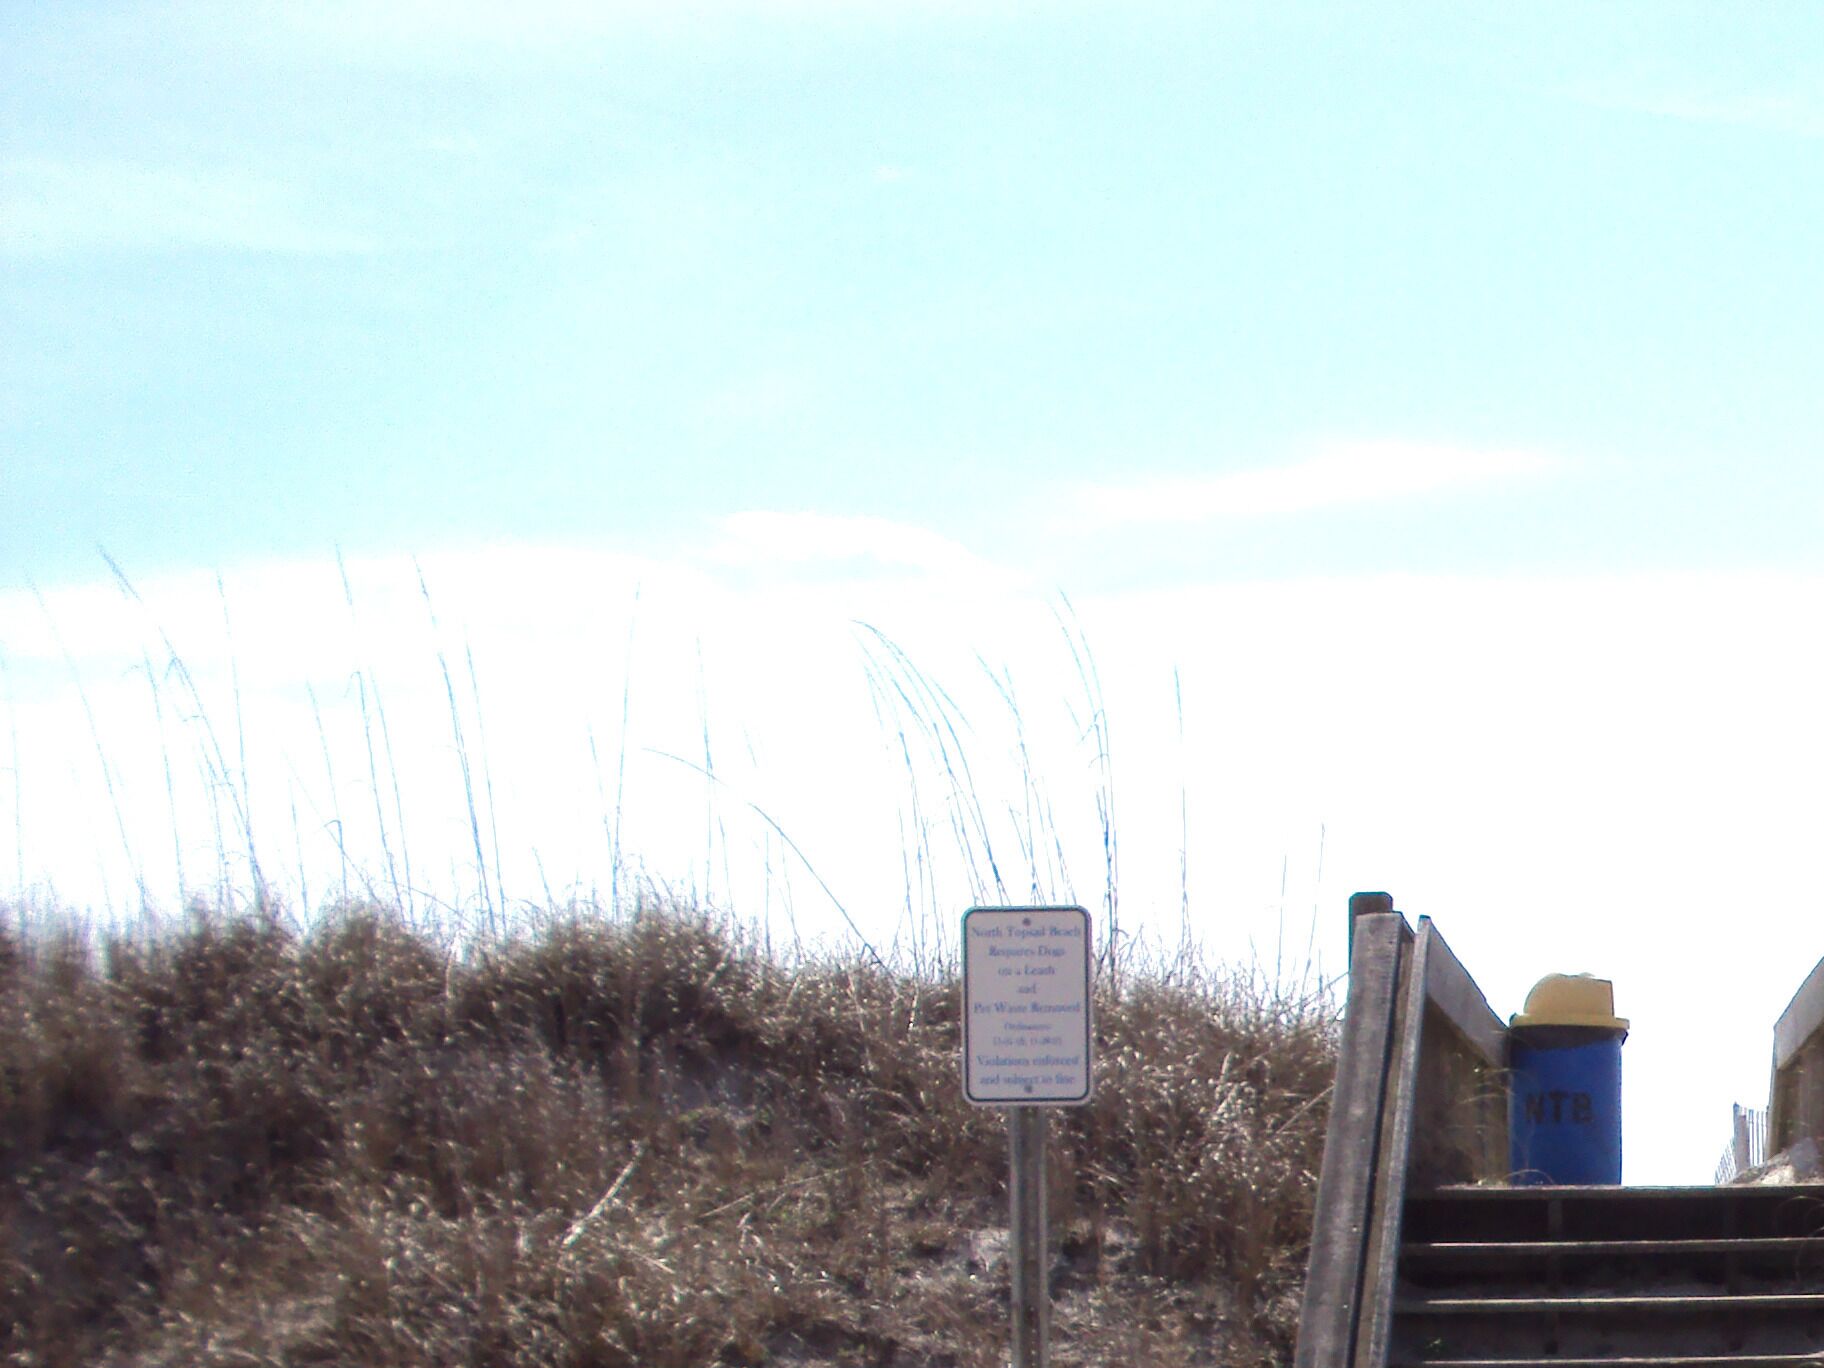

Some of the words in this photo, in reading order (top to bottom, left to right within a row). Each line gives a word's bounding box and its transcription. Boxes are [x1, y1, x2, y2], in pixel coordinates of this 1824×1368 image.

[972, 926, 1003, 938] North
[1006, 926, 1046, 940] Topsail
[1049, 925, 1081, 937] Beach
[1038, 944, 1066, 958] Dogs
[1024, 965, 1056, 976] Leash
[1017, 982, 1037, 994] and
[973, 1002, 991, 1014] Pet
[994, 1001, 1027, 1013] Waste
[976, 1055, 1030, 1066] Violations
[1032, 1054, 1080, 1066] enforced
[980, 1073, 1000, 1085] and
[1524, 1090, 1594, 1125] NTB
